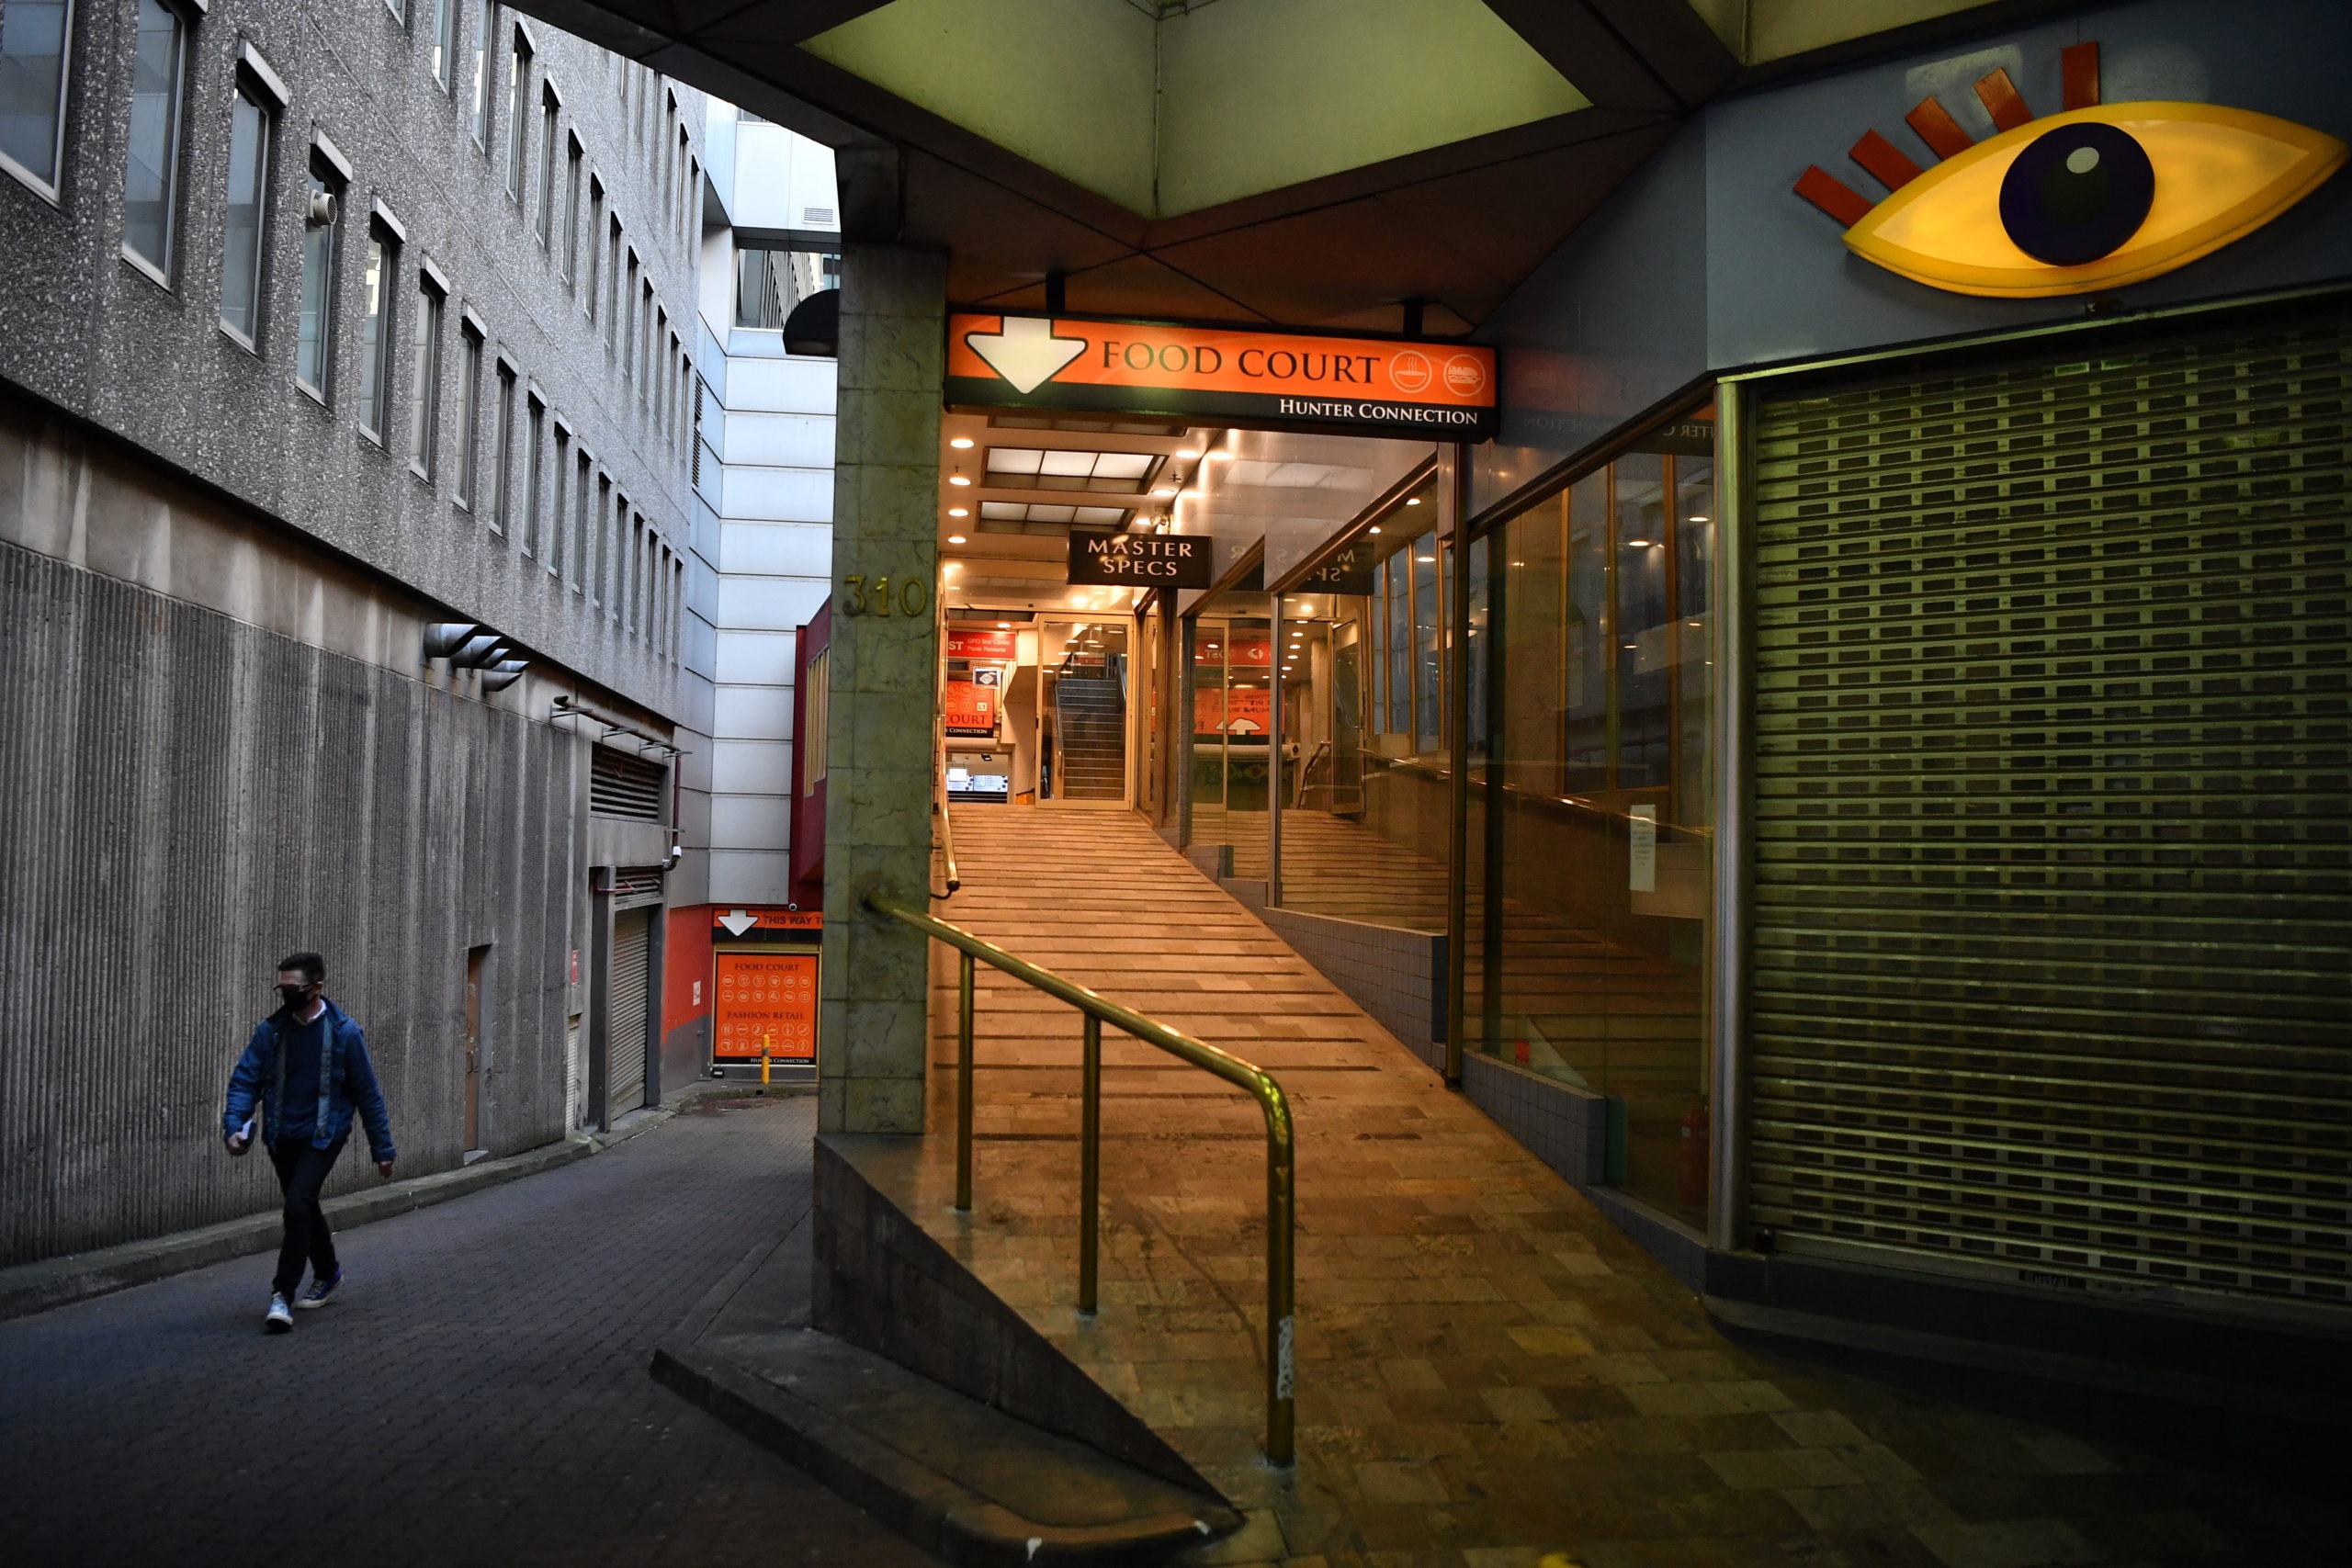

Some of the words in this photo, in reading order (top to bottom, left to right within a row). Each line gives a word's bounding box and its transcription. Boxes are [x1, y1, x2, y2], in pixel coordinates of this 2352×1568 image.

[1102, 341, 1222, 374] FOOD
[1238, 349, 1381, 384] COURT
[1279, 399, 1354, 418] HUNTER
[1359, 403, 1477, 424] CONNECTION
[1088, 538, 1193, 558] MASTER
[1102, 558, 1178, 576] SPECS
[842, 575, 927, 617] 310
[763, 916, 786, 925] THIS
[790, 916, 811, 925] WAY
[734, 963, 763, 971] FOOD
[765, 963, 801, 972] COURT
[773, 1011, 805, 1020] RETAIL
